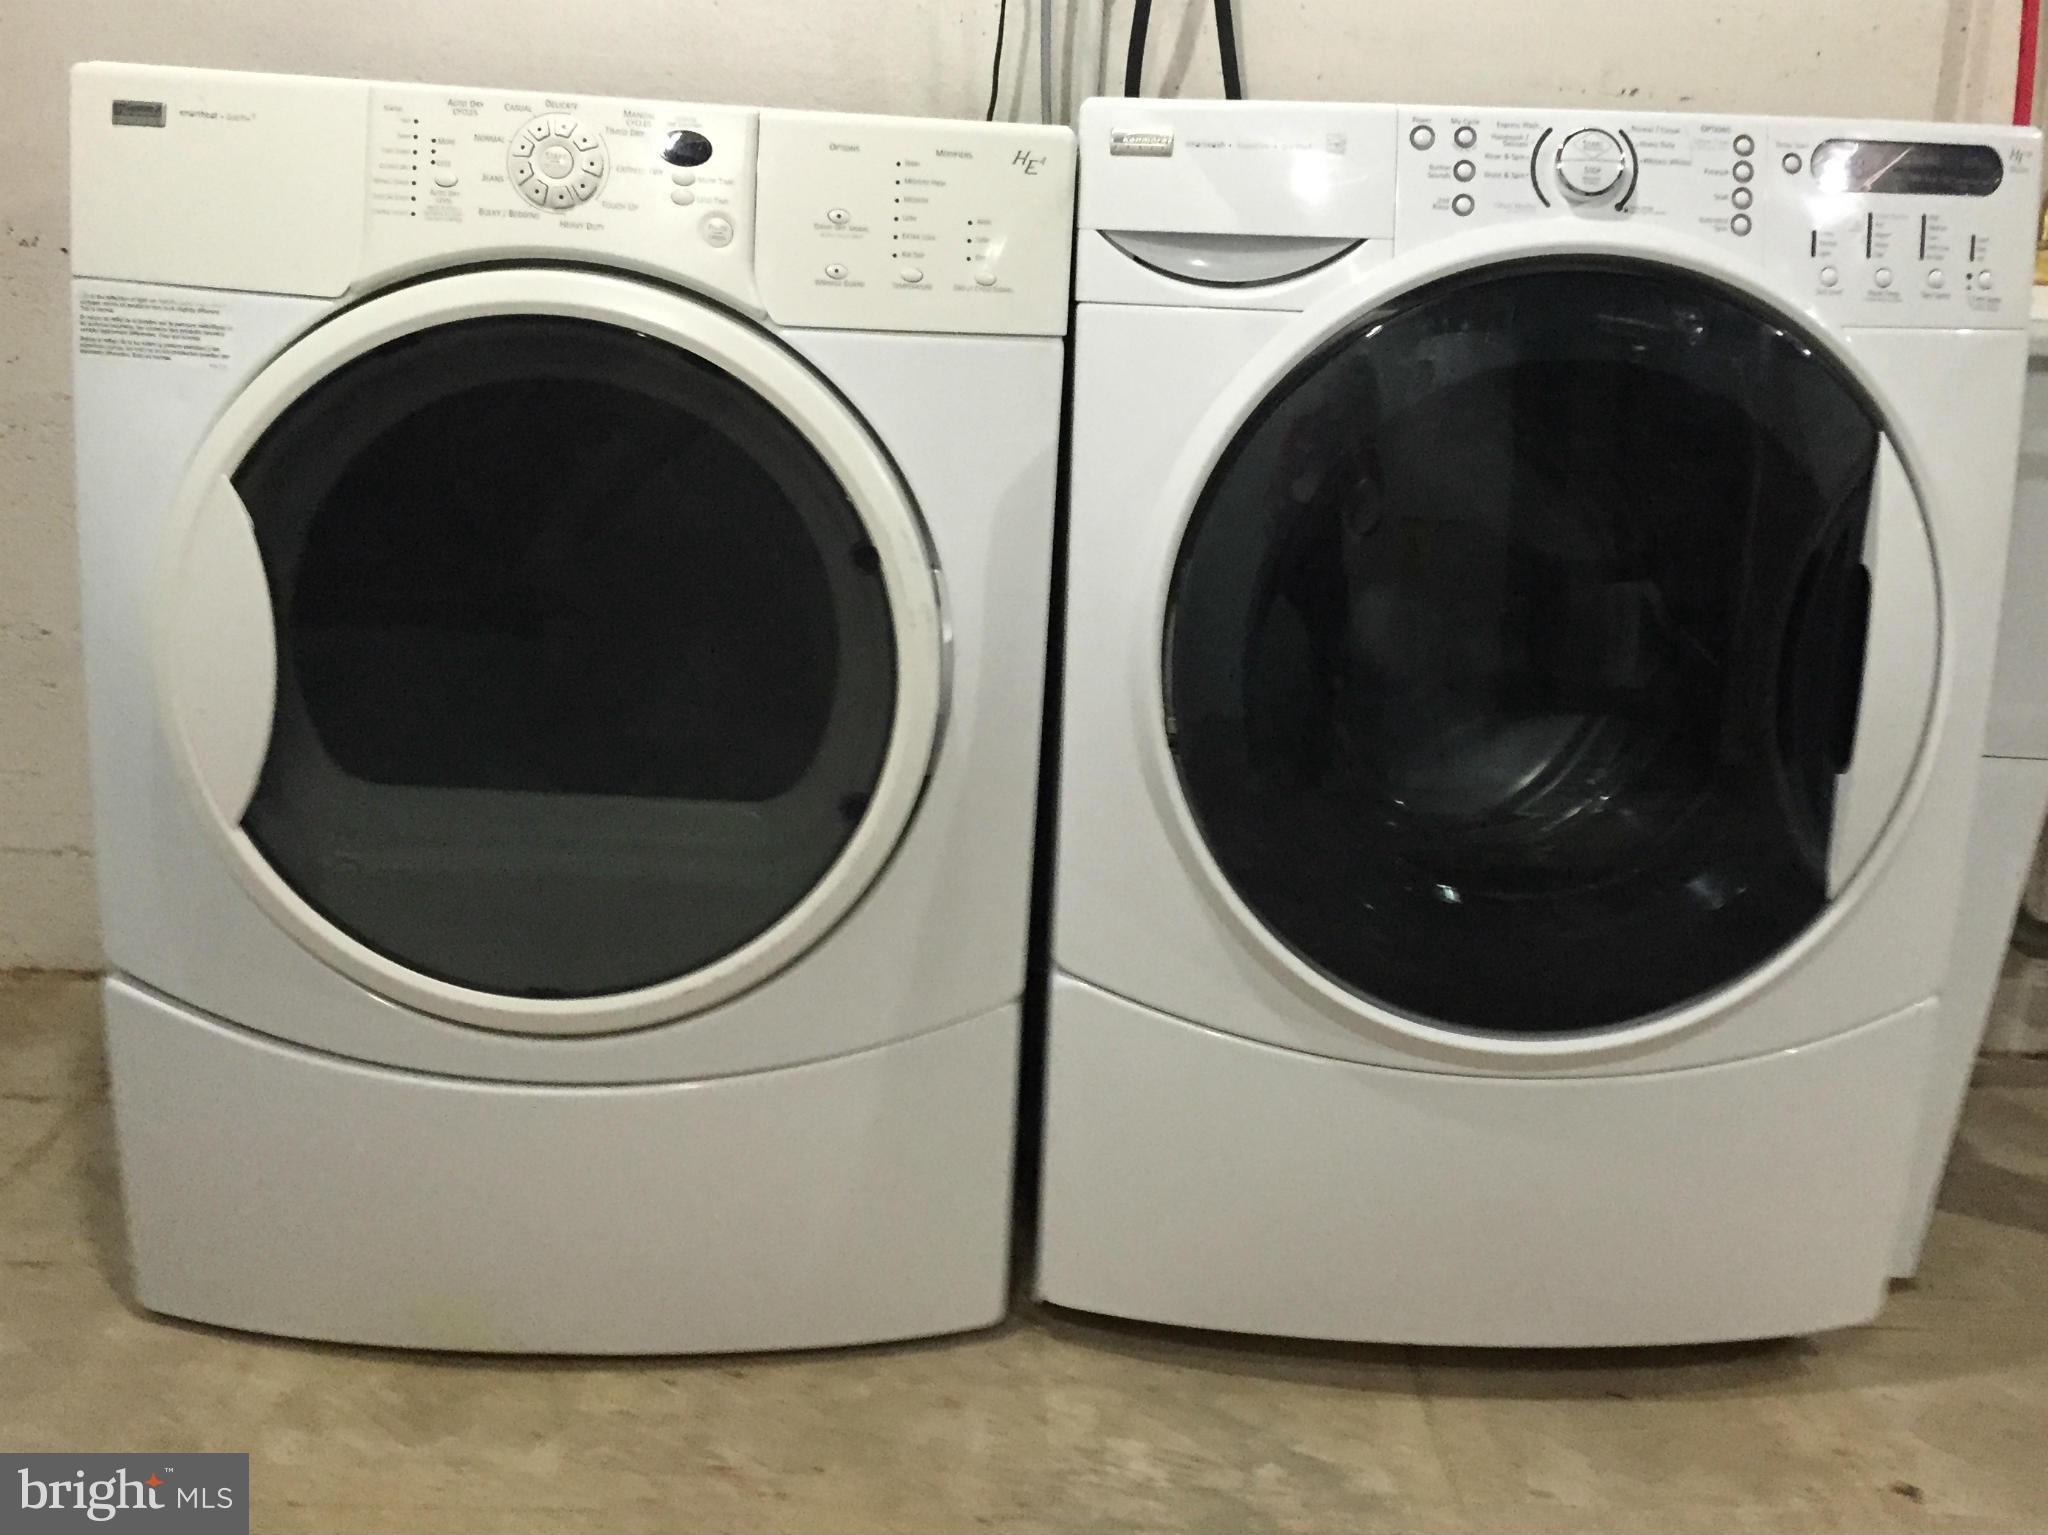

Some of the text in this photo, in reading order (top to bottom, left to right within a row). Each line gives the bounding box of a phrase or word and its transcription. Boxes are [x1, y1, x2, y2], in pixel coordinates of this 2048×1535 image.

[504, 103, 533, 112] CASUAL
[474, 133, 504, 143] NORMAL
[482, 174, 504, 183] JEANS
